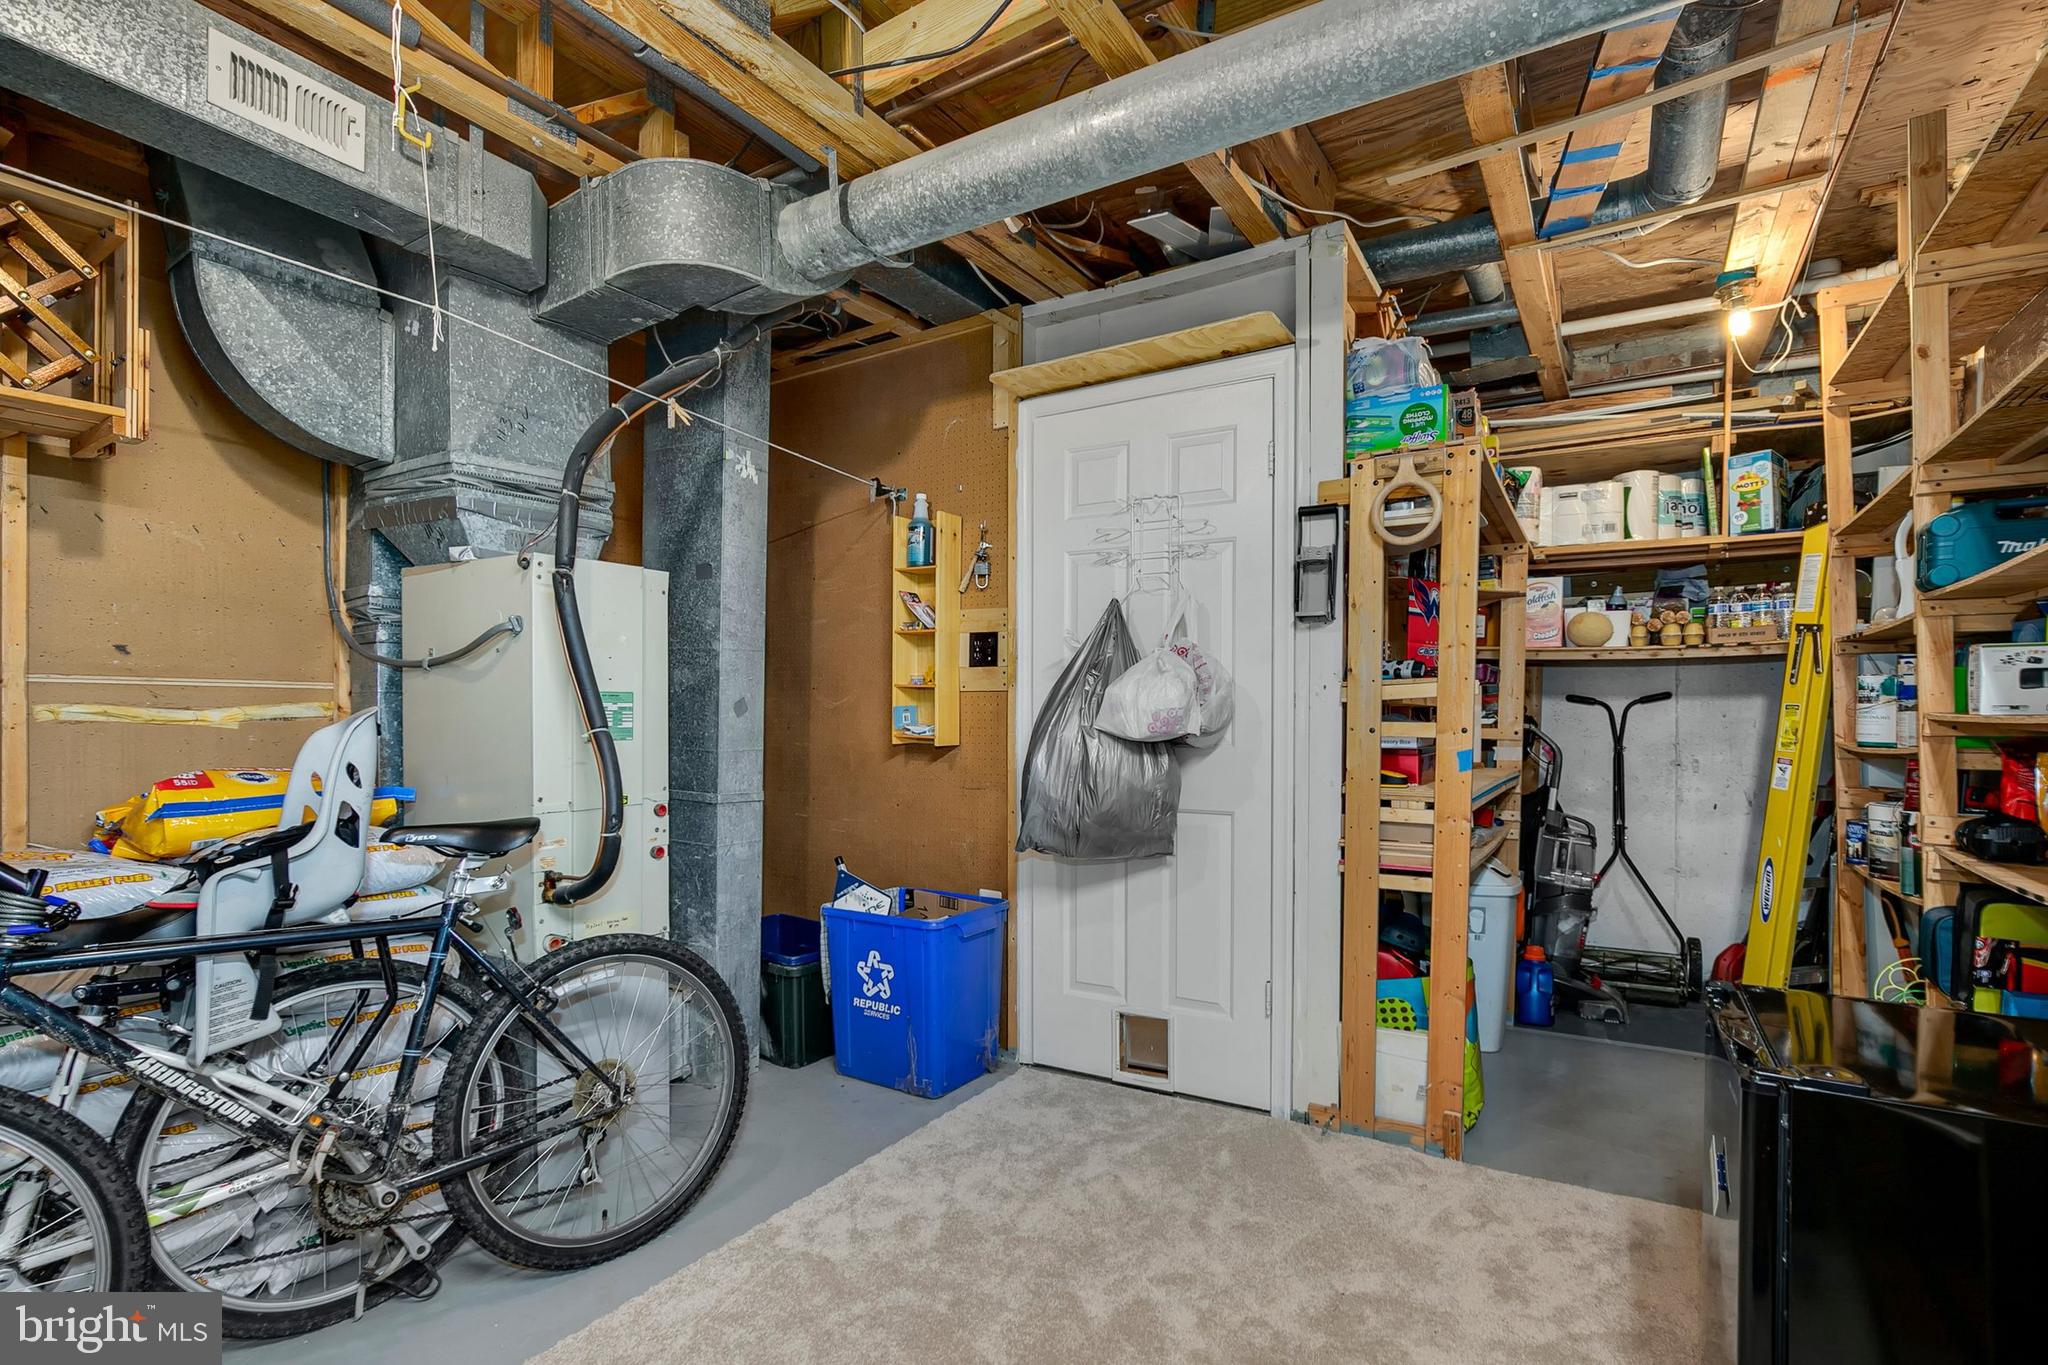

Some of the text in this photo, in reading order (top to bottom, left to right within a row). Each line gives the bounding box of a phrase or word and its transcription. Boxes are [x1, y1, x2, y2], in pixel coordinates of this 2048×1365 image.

[1461, 408, 1473, 419] 48
[1402, 430, 1440, 444] Swiffer
[1527, 590, 1557, 606] oldfish
[55, 875, 113, 893] PELLET
[113, 873, 154, 885] FUEL
[1762, 869, 1772, 911] WERNER
[402, 944, 429, 953] FUEL
[853, 997, 901, 1016] REPUBLIC
[863, 1010, 890, 1021] SERVICES
[126, 1053, 261, 1127] BRIDGESTONE
